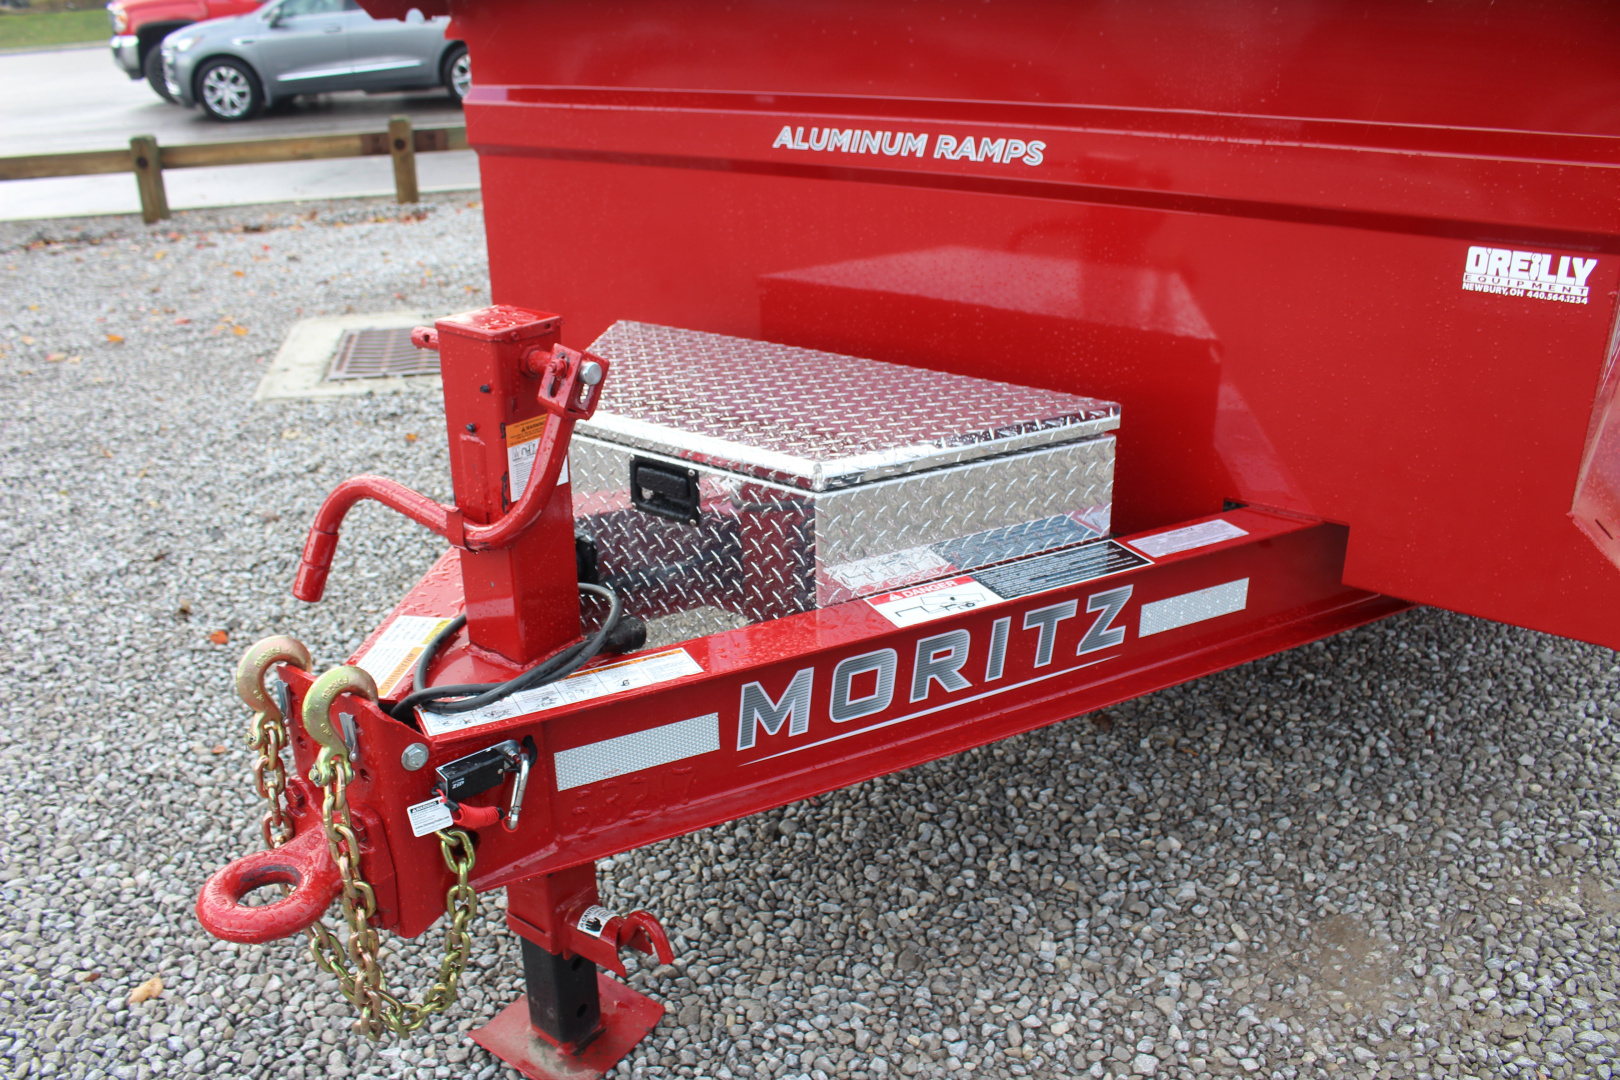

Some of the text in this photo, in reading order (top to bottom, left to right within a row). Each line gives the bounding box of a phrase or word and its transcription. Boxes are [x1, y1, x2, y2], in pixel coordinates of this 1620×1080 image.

[772, 126, 1046, 166] ALUMINUM RAMPS
[1464, 273, 1588, 294] EQUIPMENT
[1527, 290, 1588, 304] 440.564.1234
[902, 580, 957, 597] DANGER
[737, 584, 1133, 751] MORITZ
